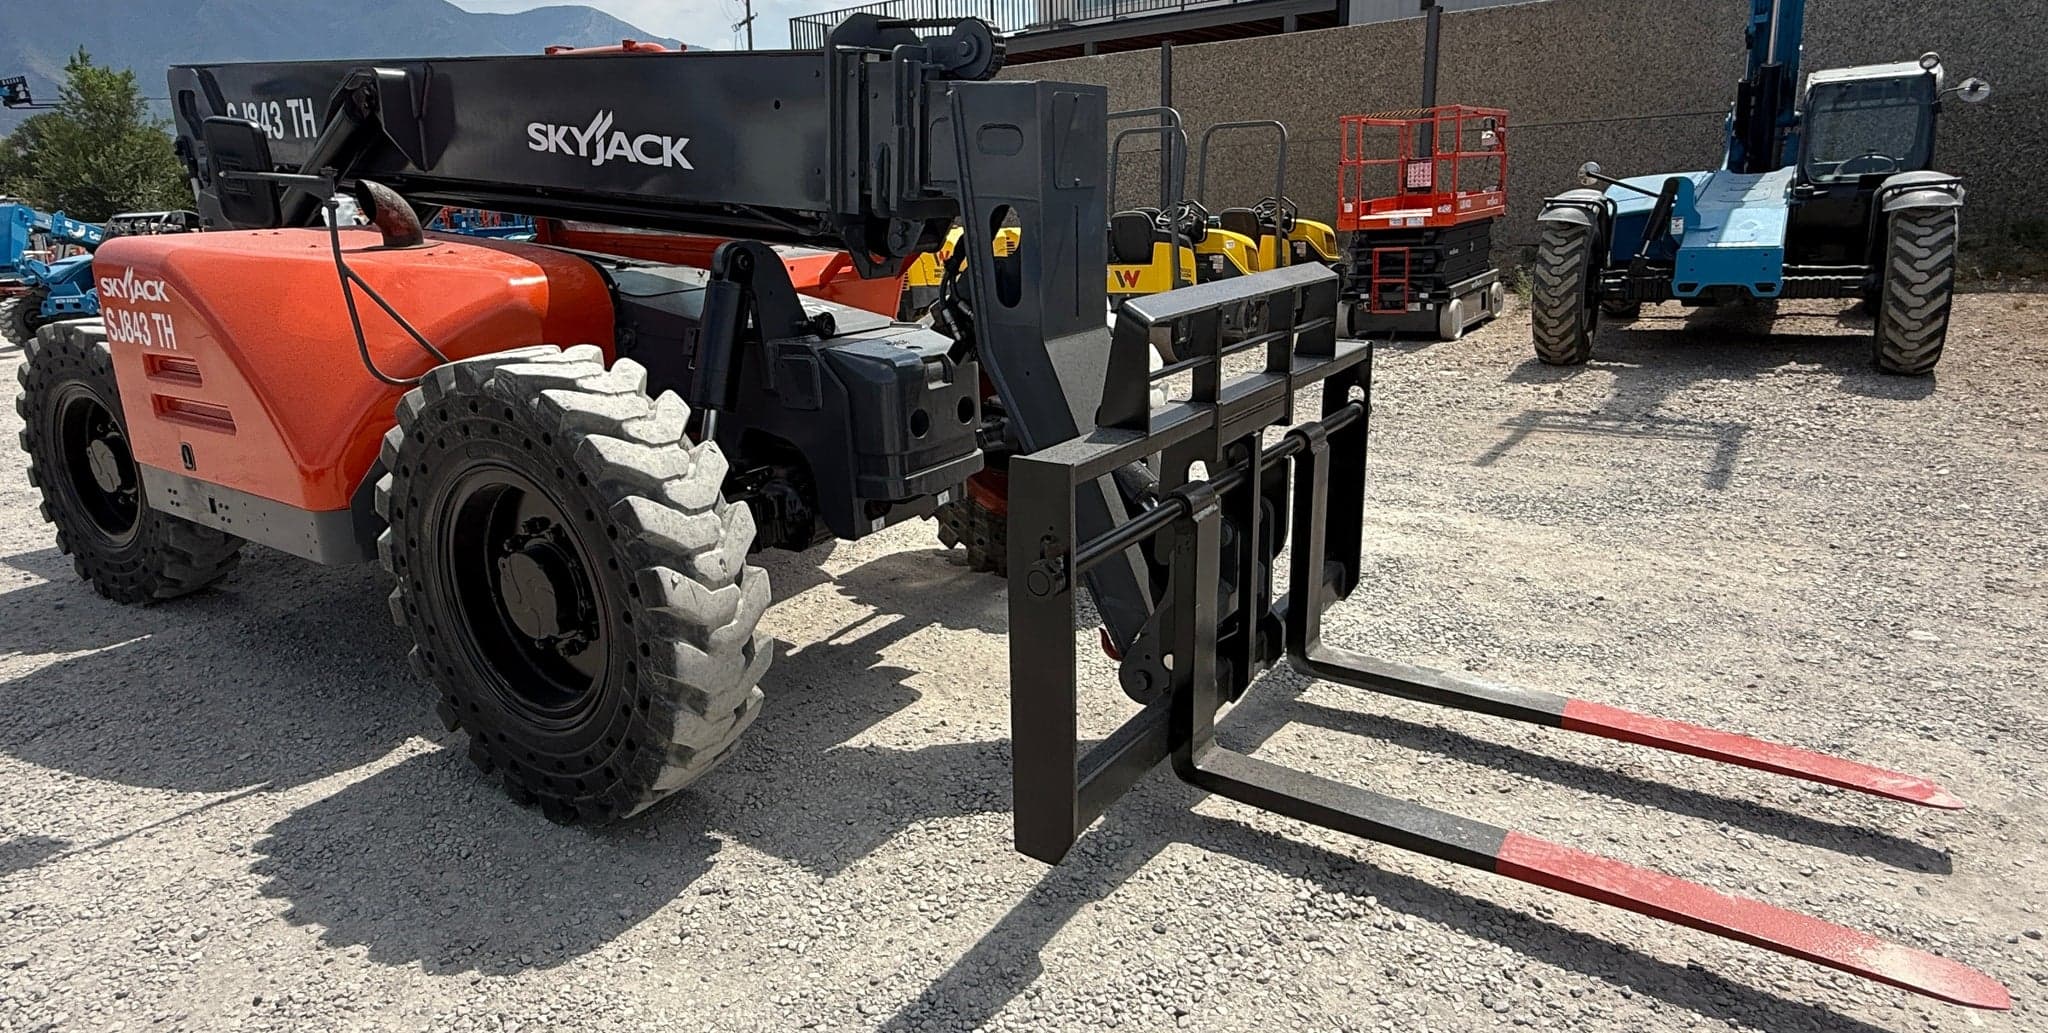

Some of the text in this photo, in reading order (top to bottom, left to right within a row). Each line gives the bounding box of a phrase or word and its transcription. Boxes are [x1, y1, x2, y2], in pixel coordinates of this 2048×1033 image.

[286, 97, 318, 138] TH
[527, 109, 694, 170] SKYJACK
[100, 266, 170, 304] SKYJACK
[106, 307, 177, 350] SJ843 TH
